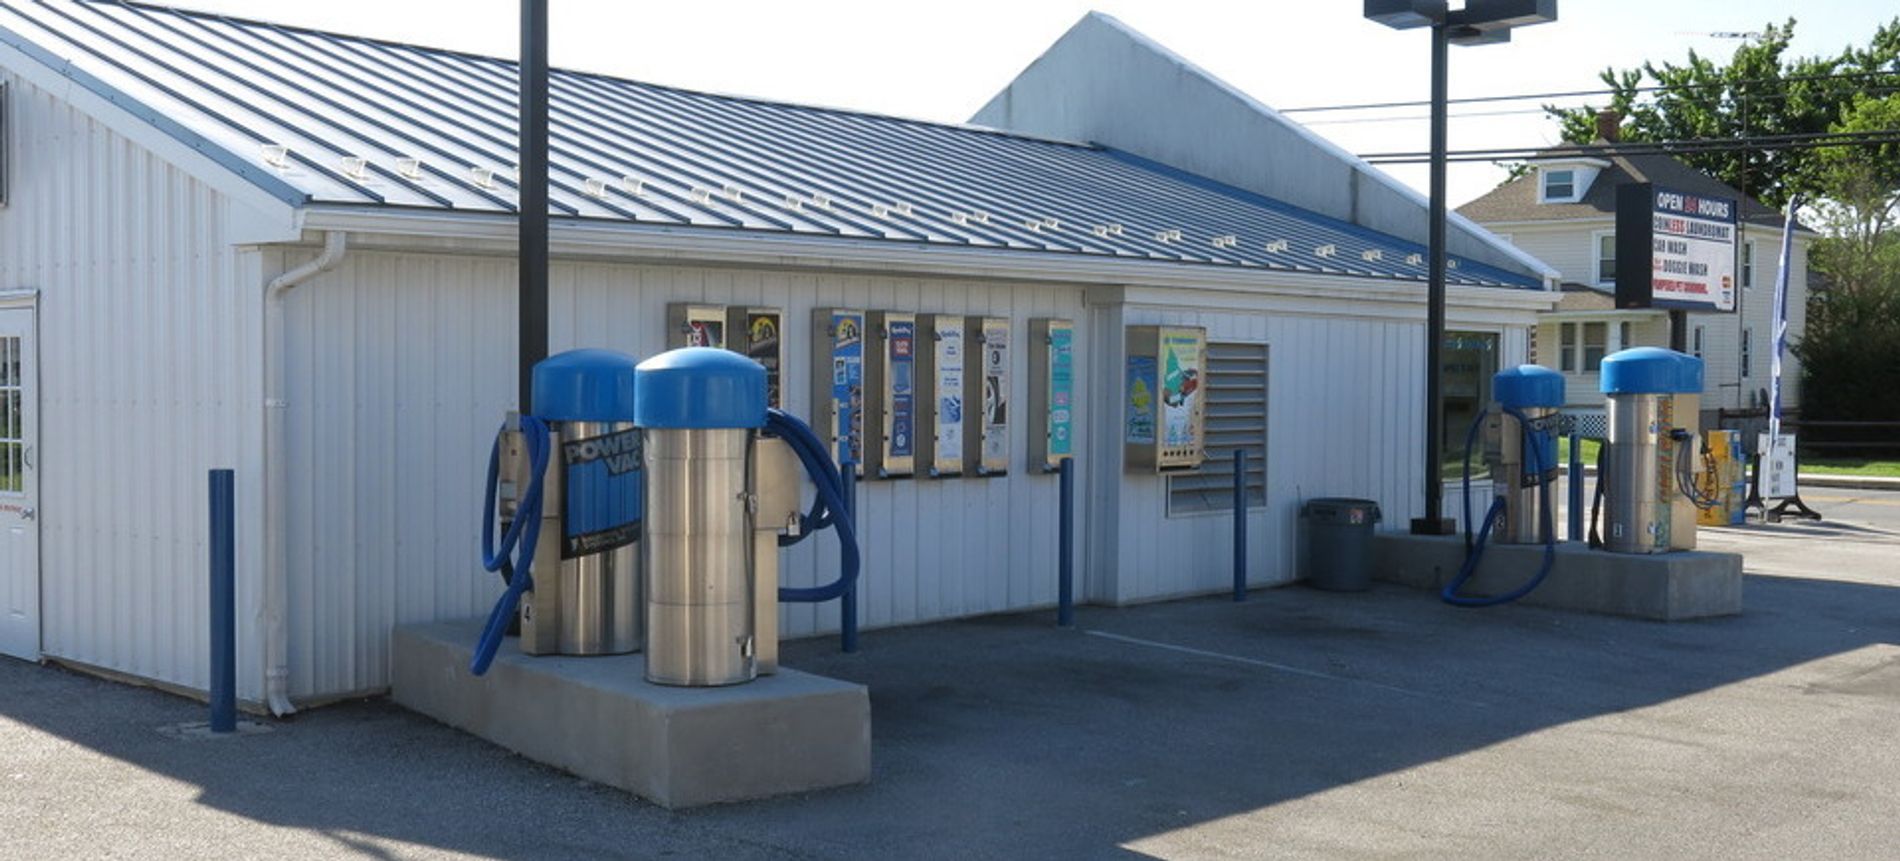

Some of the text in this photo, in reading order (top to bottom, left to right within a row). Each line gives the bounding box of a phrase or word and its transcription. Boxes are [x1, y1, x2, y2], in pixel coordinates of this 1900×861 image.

[1657, 192, 1683, 211] OPEN
[1698, 198, 1729, 217] HOURS
[1686, 220, 1730, 239] LAUNDROMAT
[1653, 239, 1687, 255] CAR WASH
[1663, 260, 1687, 274] DOGGIE
[1689, 263, 1708, 276] WASH
[565, 430, 640, 463] POWER
[606, 449, 640, 474] VAC
